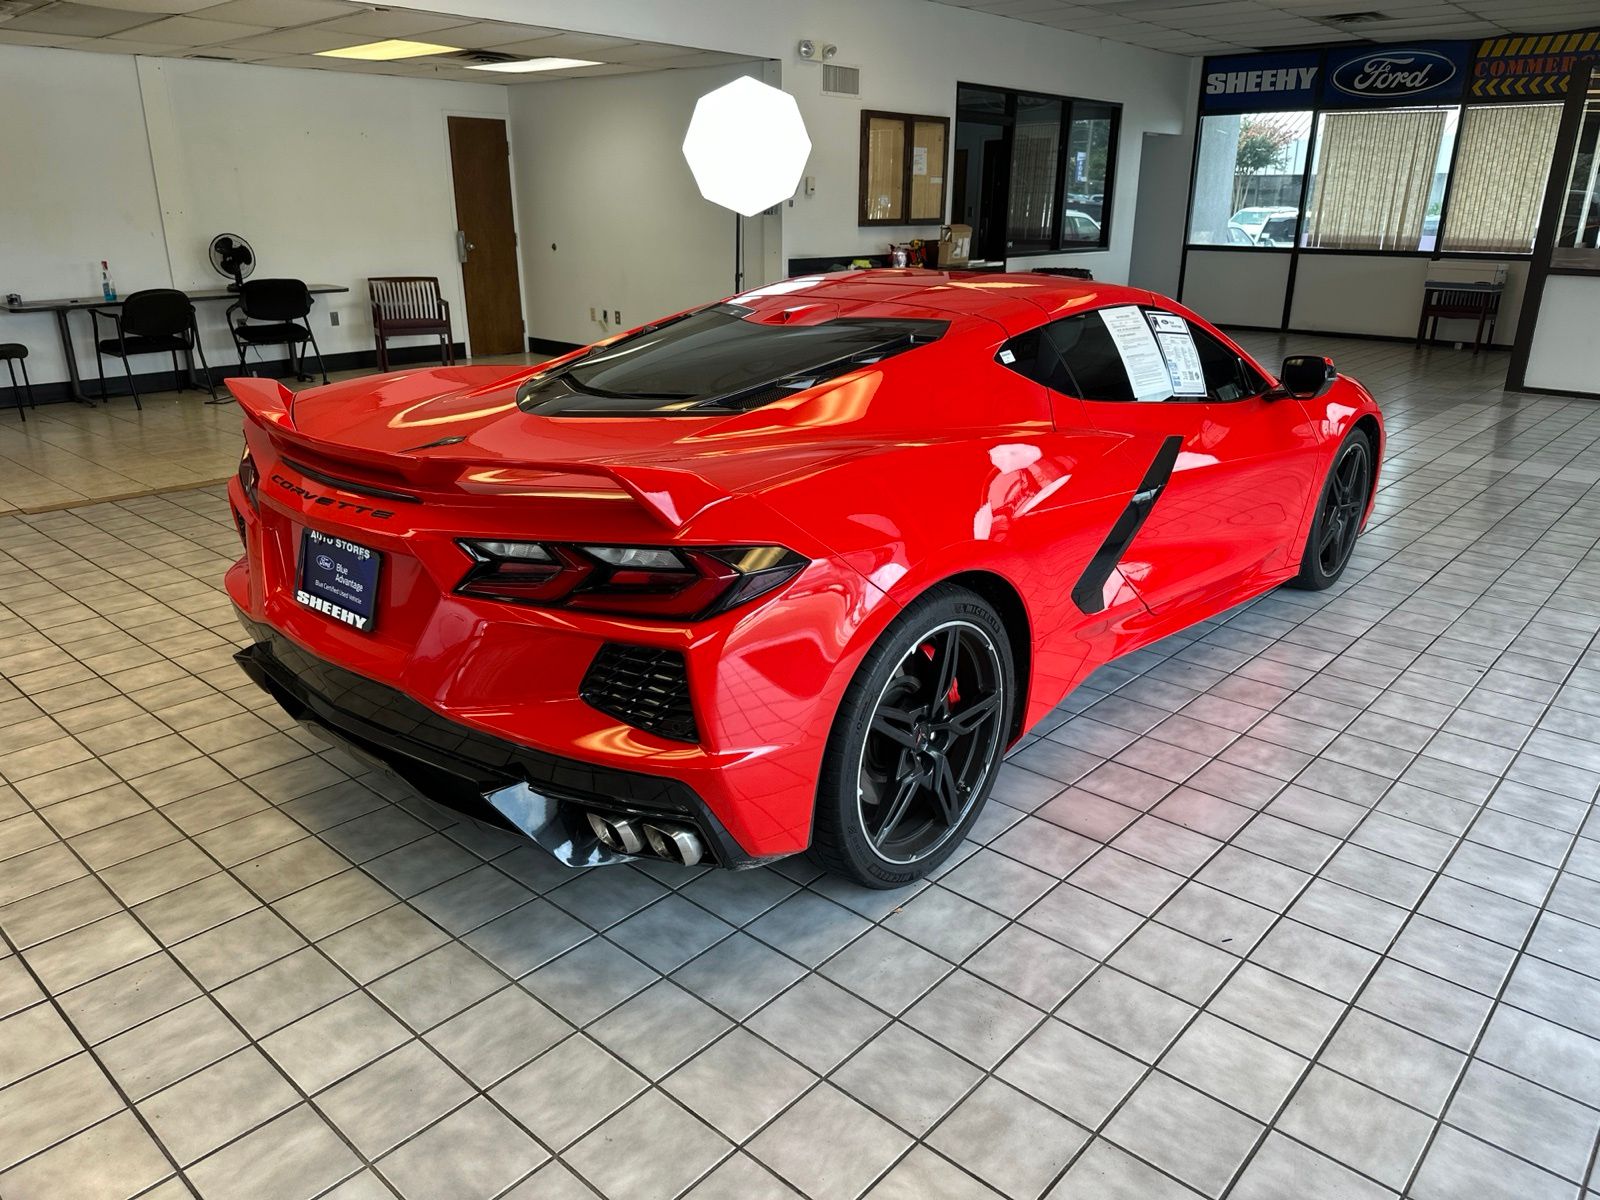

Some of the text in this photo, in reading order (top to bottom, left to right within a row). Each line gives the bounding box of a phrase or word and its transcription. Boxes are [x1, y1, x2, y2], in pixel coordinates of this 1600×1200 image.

[1354, 57, 1431, 90] Ford
[1474, 55, 1596, 77] COMMER
[1206, 67, 1318, 94] SHEEHY
[272, 475, 395, 519] CORVETTE
[335, 538, 370, 559] STORES
[335, 563, 349, 575] Blue
[335, 573, 364, 593] Advantage
[297, 590, 367, 629] SHEEHY
